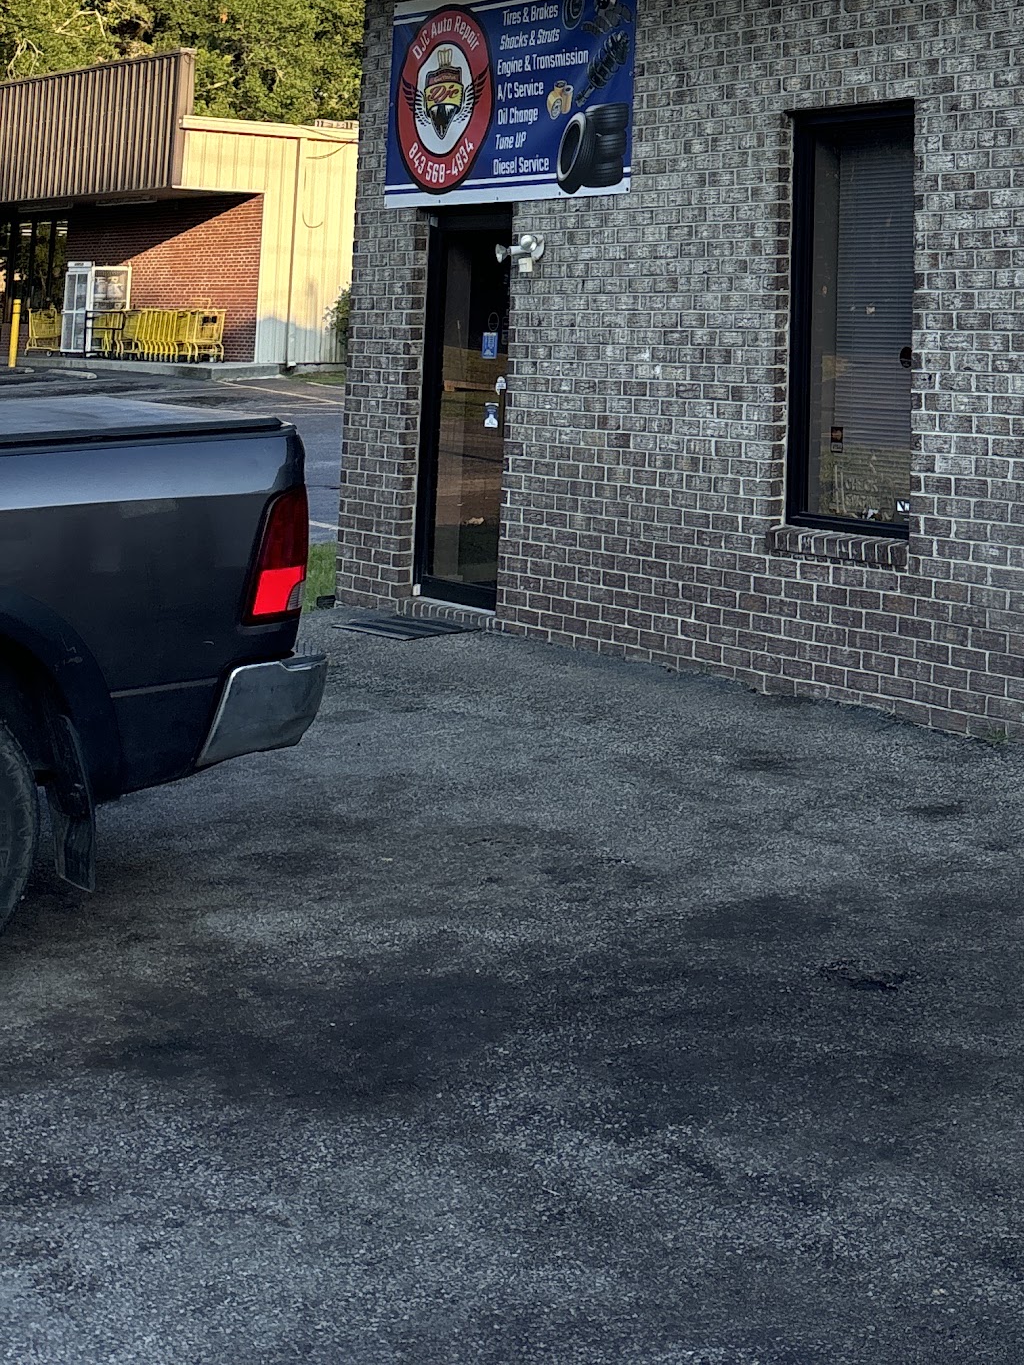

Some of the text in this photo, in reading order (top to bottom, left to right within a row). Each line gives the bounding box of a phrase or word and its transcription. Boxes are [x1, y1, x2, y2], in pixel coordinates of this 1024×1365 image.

[503, 2, 559, 27] Tires & Brakes
[412, 15, 480, 60] DJC Auto Repair
[500, 27, 560, 51] Shocks & Struts
[497, 47, 589, 77] Engine & Transmission
[497, 78, 544, 102] A/C Service
[497, 106, 539, 125] Oil Change
[495, 131, 527, 150] Tune UP
[408, 137, 474, 183] 843 568-4834
[493, 154, 550, 175] Diesel Service
